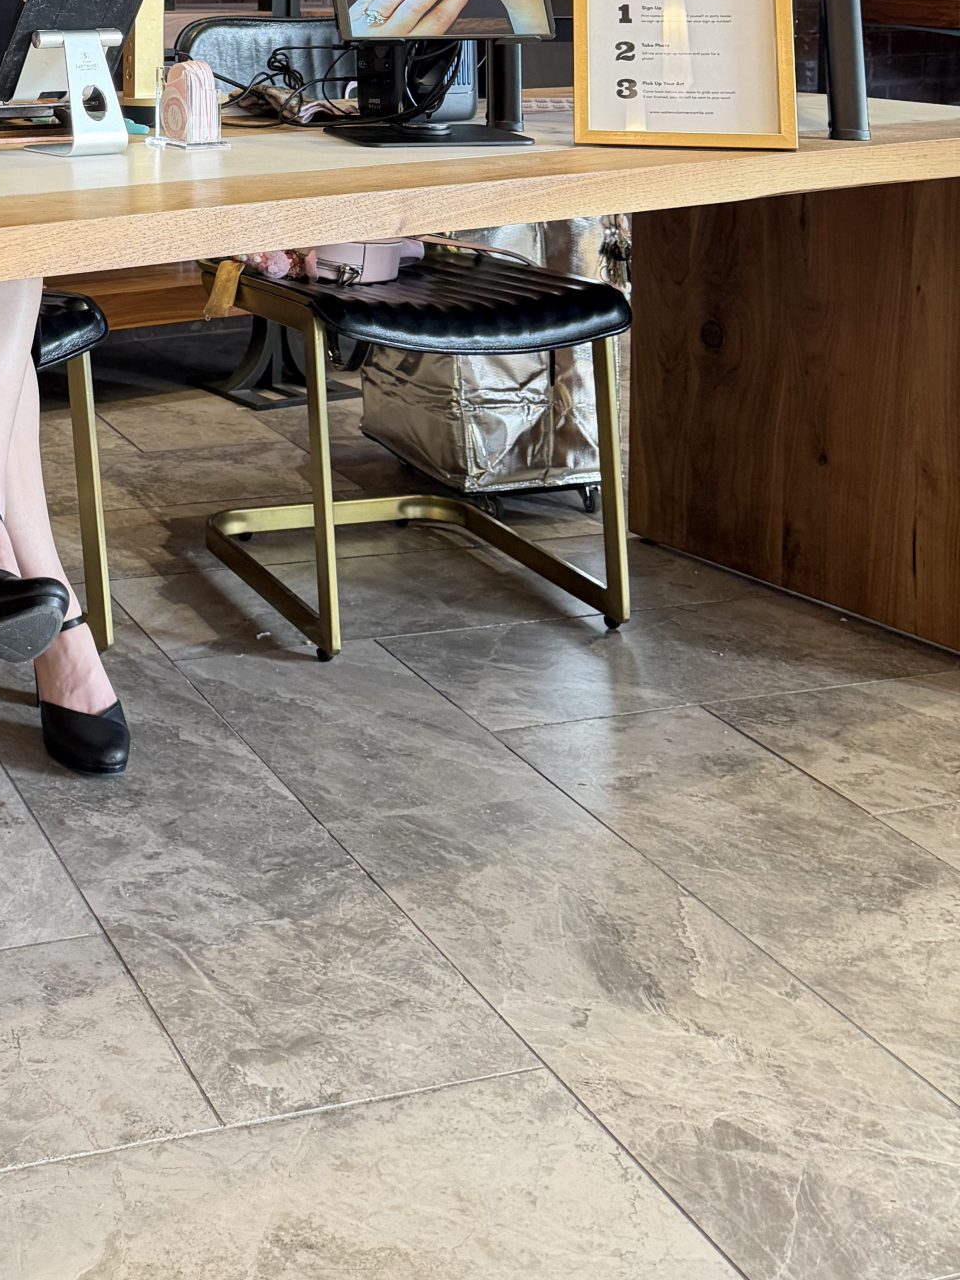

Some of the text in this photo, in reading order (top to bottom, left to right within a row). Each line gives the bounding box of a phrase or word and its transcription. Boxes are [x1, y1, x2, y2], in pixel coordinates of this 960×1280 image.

[618, 4, 633, 24] 1
[615, 41, 636, 61] 2
[616, 78, 638, 99] 3
